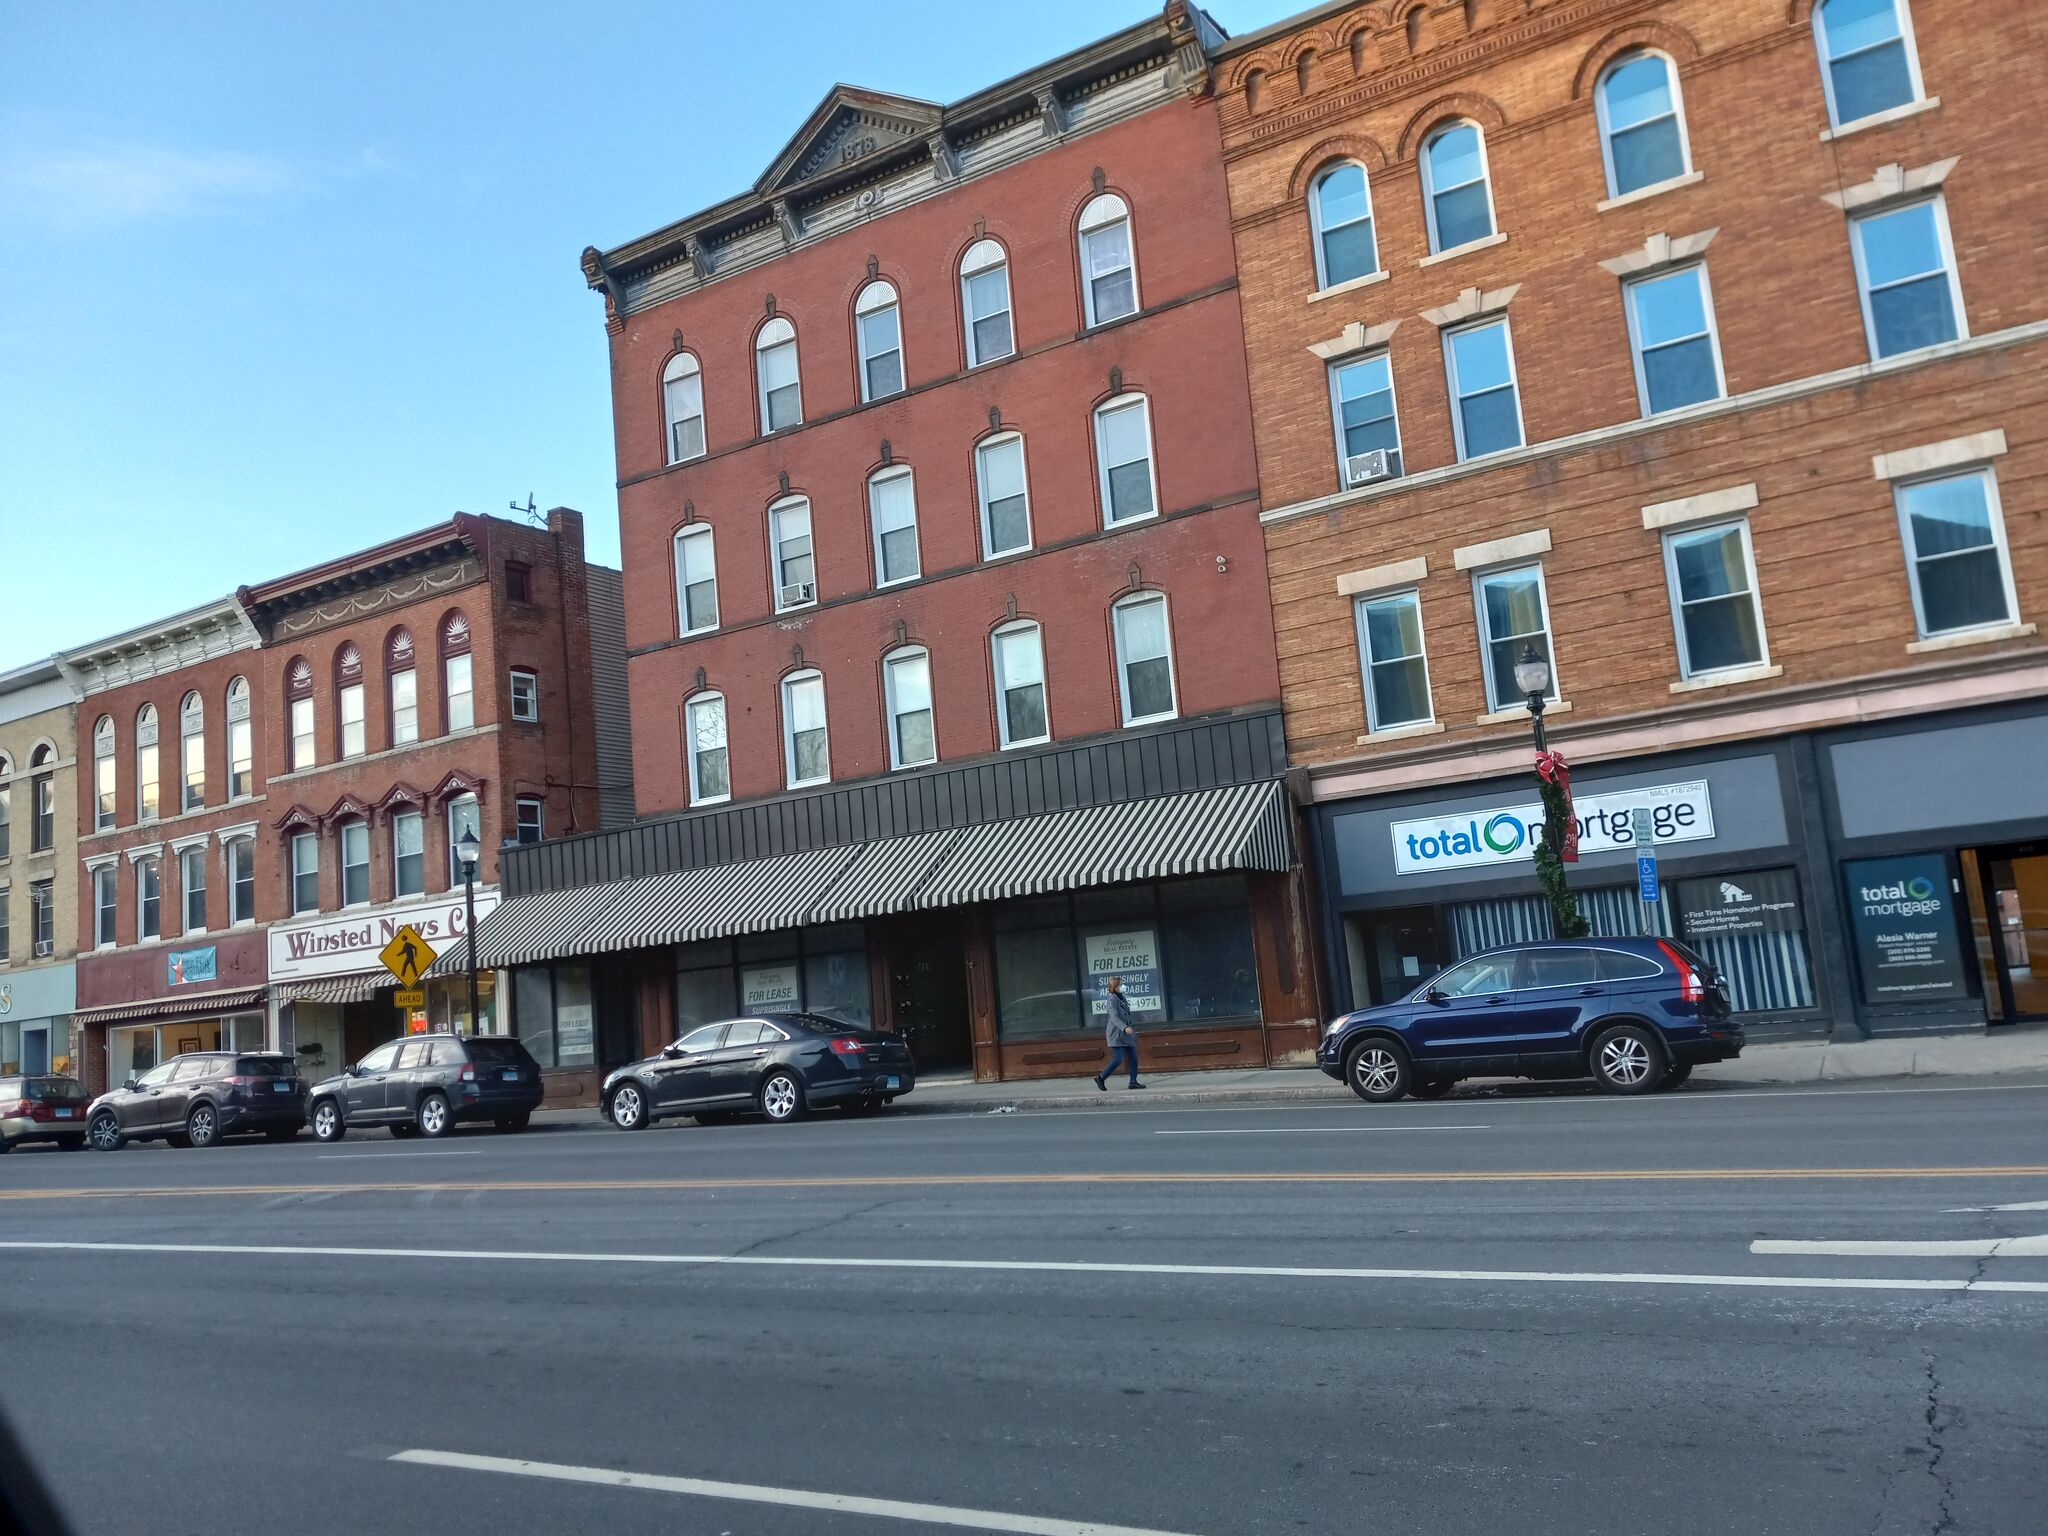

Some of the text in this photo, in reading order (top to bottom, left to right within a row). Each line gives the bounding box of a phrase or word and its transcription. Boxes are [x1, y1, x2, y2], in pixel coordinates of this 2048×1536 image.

[1406, 820, 1483, 860] total
[1527, 801, 1697, 845] rtgge
[1861, 880, 1907, 901] total
[1723, 905, 1761, 914] Homebuyer
[1761, 902, 1795, 910] Programs
[1864, 899, 1941, 916] mortgage
[1691, 920, 1763, 933] Investment Properties
[286, 924, 372, 959] Winsted
[1905, 932, 1938, 940] Warner
[1093, 955, 1149, 971] FOR LEASE
[1098, 973, 1149, 986] SUSINGLY
[748, 987, 792, 1002] FOR LEASE
[1099, 984, 1150, 997] AFDABLE
[399, 994, 421, 1004] AHEAD
